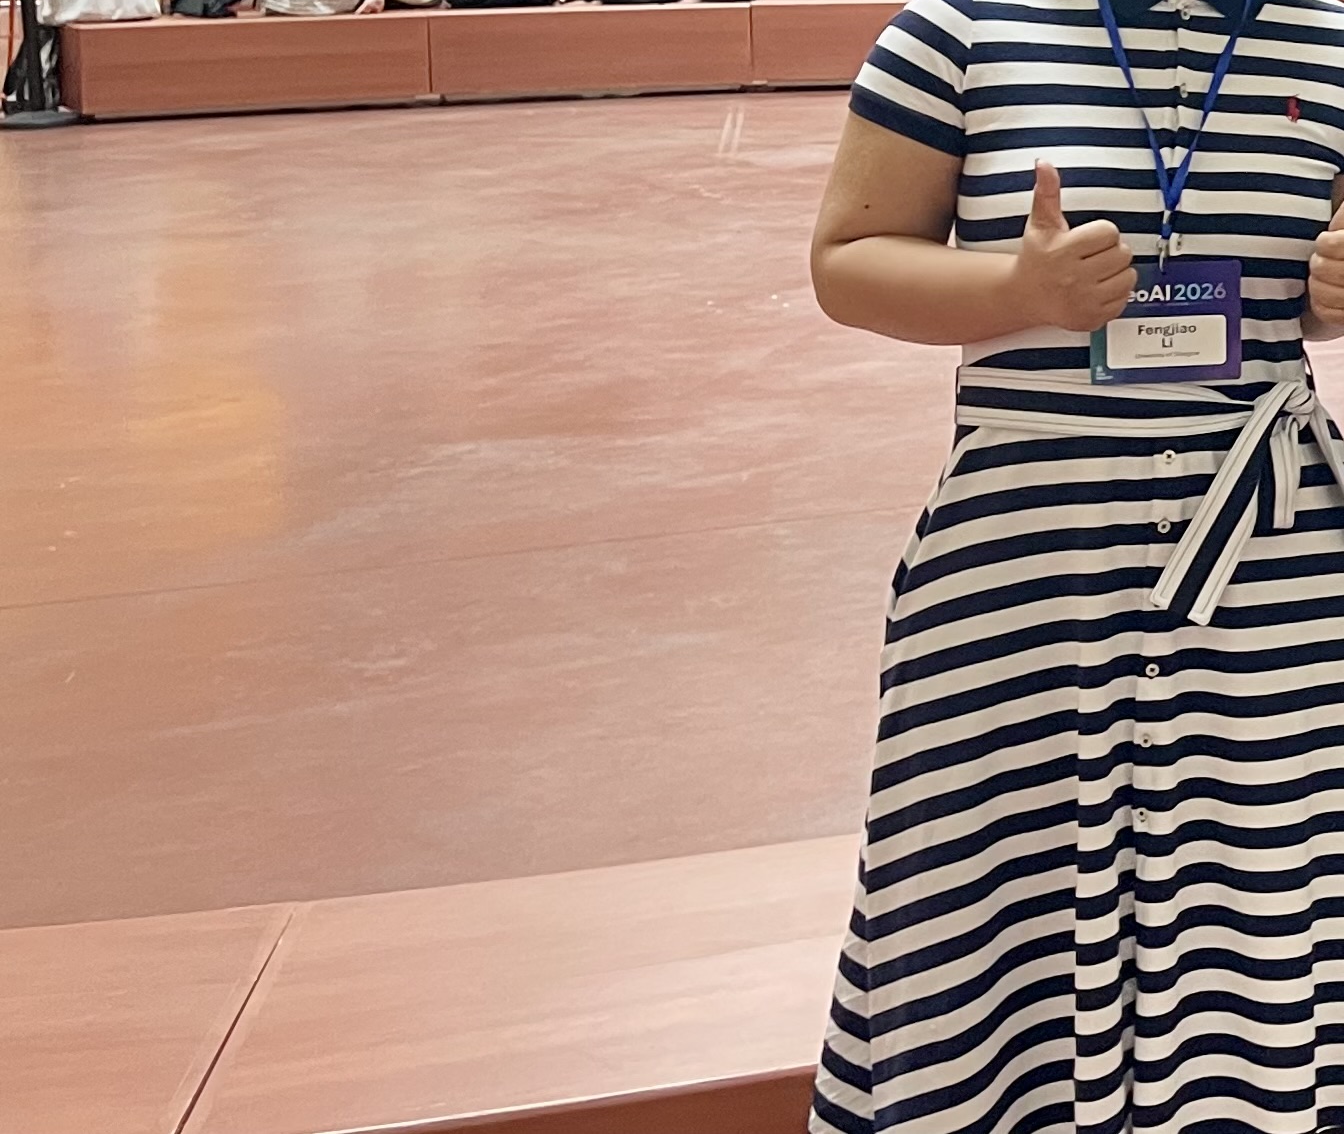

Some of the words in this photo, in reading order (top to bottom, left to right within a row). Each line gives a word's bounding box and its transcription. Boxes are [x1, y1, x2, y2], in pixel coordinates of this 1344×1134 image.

[1127, 284, 1170, 302] eoAI
[1174, 283, 1226, 301] 2026
[1138, 323, 1197, 336] Fengjiao
[1161, 337, 1173, 348] Li
